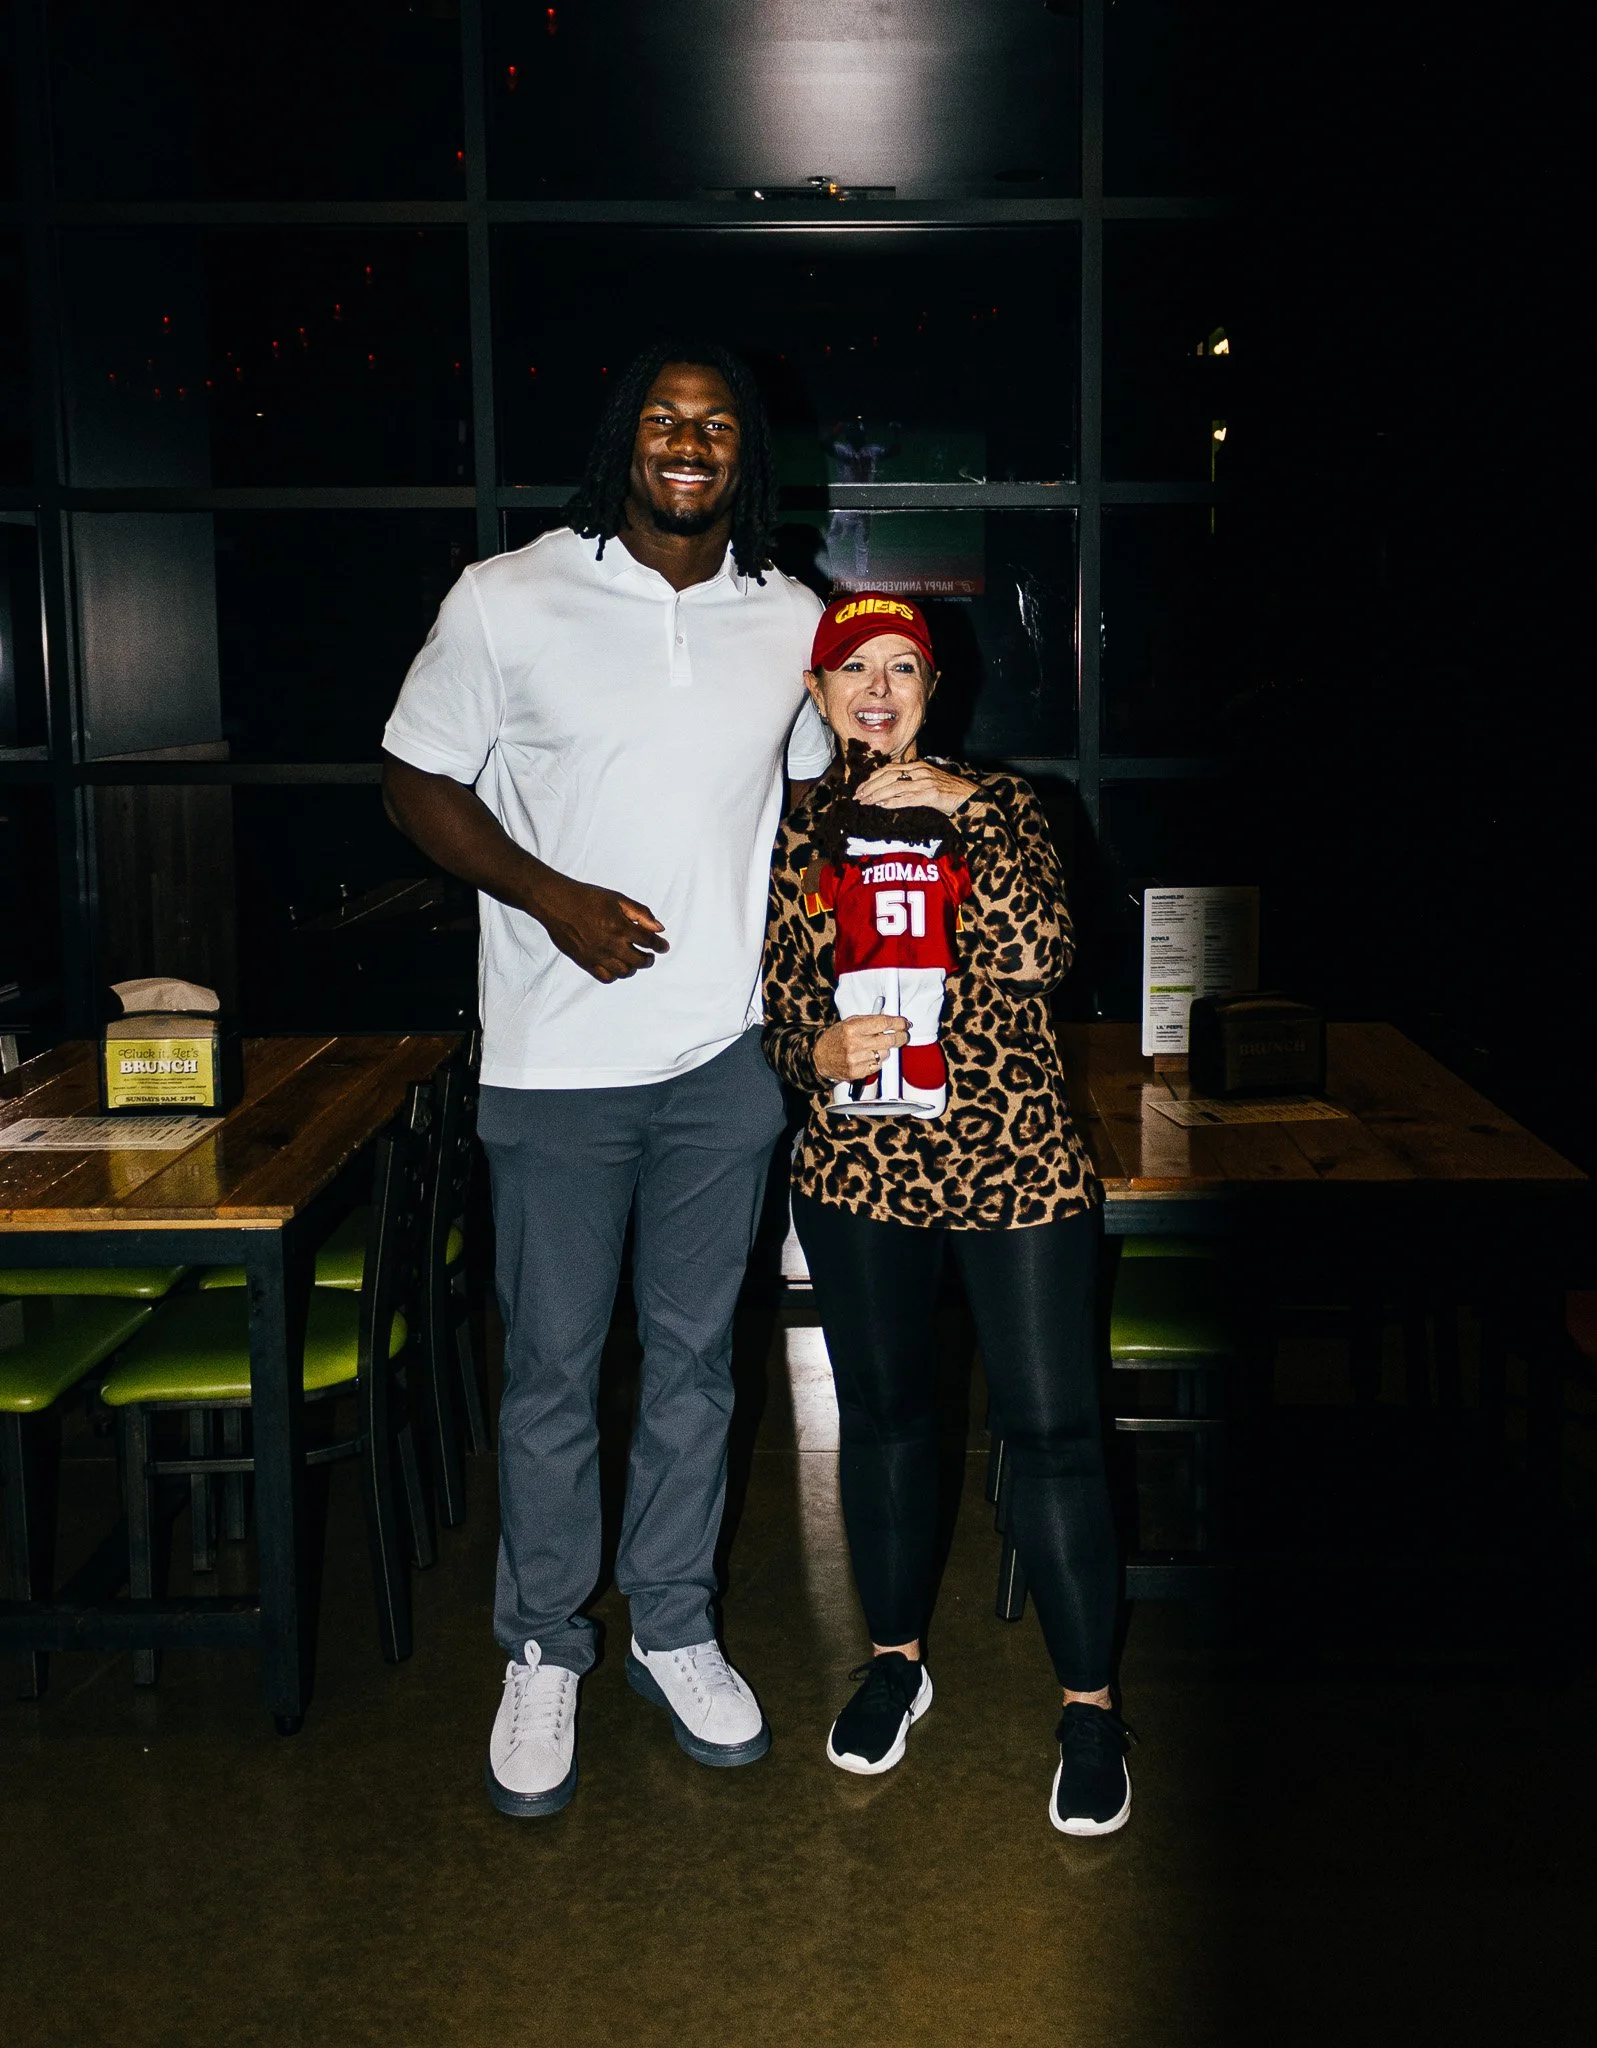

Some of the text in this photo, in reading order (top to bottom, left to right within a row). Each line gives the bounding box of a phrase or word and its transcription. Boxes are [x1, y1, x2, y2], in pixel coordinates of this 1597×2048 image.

[835, 599, 914, 624] CHIEFS
[862, 862, 939, 885] THOMAS
[875, 890, 925, 938] 51
[118, 1048, 156, 1059] Cluck
[172, 1047, 199, 1061] Let's
[1239, 1040, 1307, 1057] BRUNCH
[120, 1060, 199, 1074] BRUNCH
